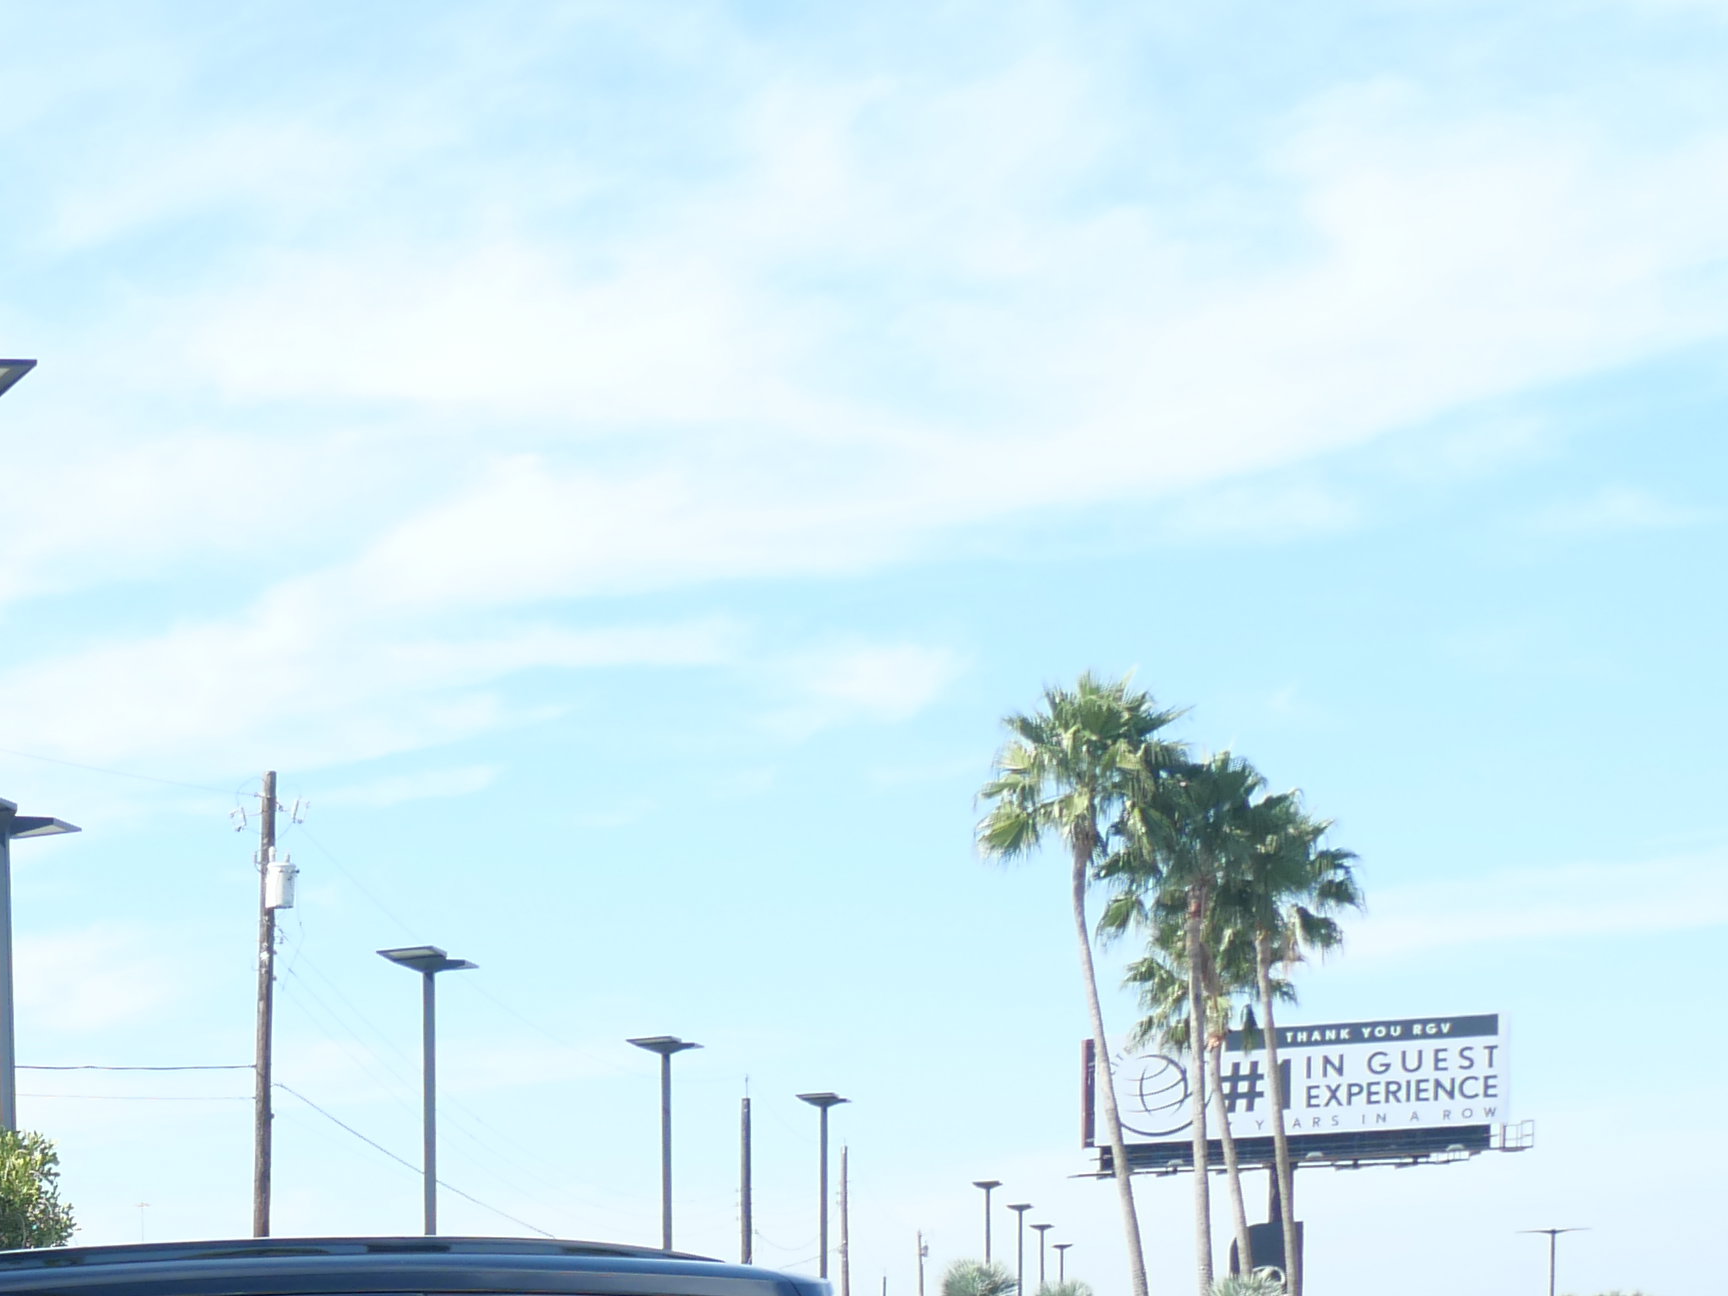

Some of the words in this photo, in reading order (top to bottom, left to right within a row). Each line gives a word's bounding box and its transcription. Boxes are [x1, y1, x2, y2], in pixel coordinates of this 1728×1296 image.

[1285, 1028, 1351, 1044] THANK
[1361, 1025, 1402, 1038] YOU
[1412, 1022, 1452, 1036] RGV
[1305, 1054, 1344, 1079] IN
[1367, 1045, 1498, 1075] GUEST
[1221, 1057, 1292, 1113] #1
[1305, 1075, 1498, 1109] EXPERIENCE
[1255, 1115, 1339, 1131] YARS
[1362, 1113, 1387, 1125] IN
[1410, 1111, 1420, 1122] A
[1442, 1107, 1497, 1120] ROW
